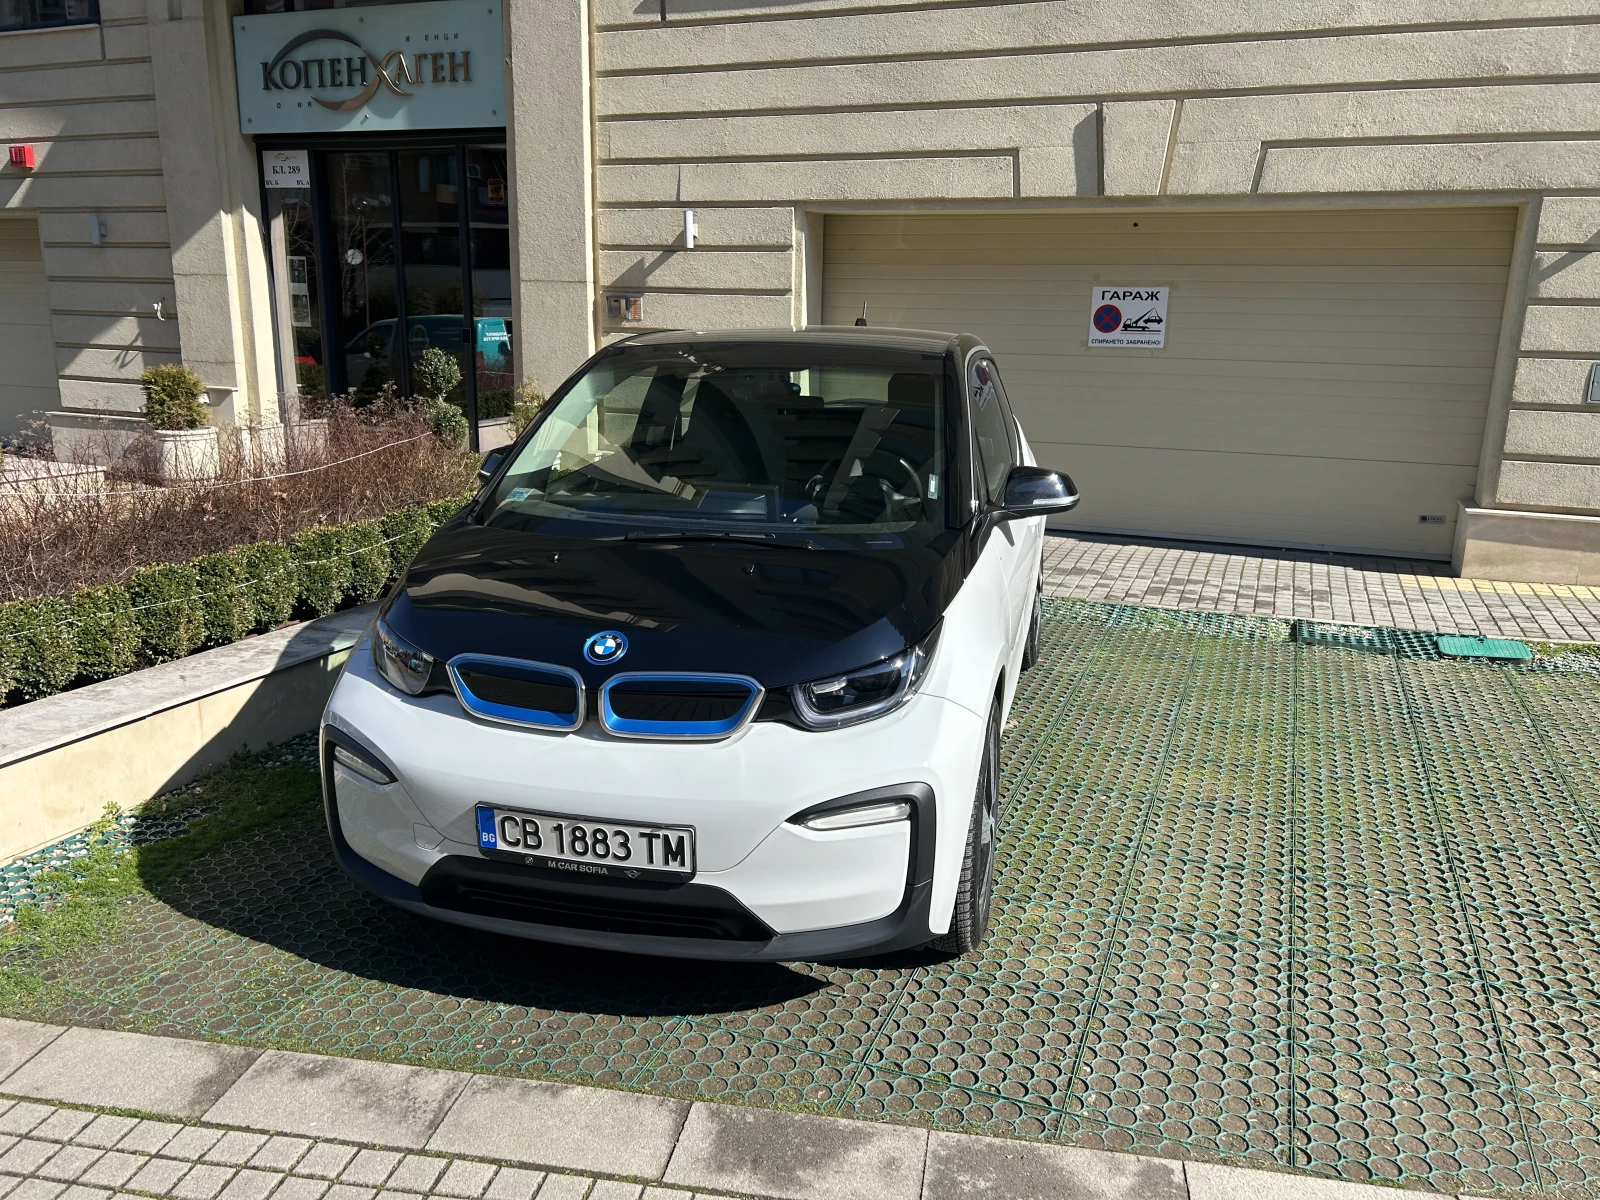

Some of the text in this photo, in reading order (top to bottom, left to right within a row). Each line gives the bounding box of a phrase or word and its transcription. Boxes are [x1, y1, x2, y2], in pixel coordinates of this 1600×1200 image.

[260, 48, 473, 97] КОПЕНХАГЕН
[272, 165, 301, 174] БЛ. 289
[1101, 290, 1161, 301] ГАРАЖ
[482, 832, 496, 843] BG
[500, 815, 687, 868] CB 1883 TM
[547, 860, 608, 875] M CAR SOFIA
